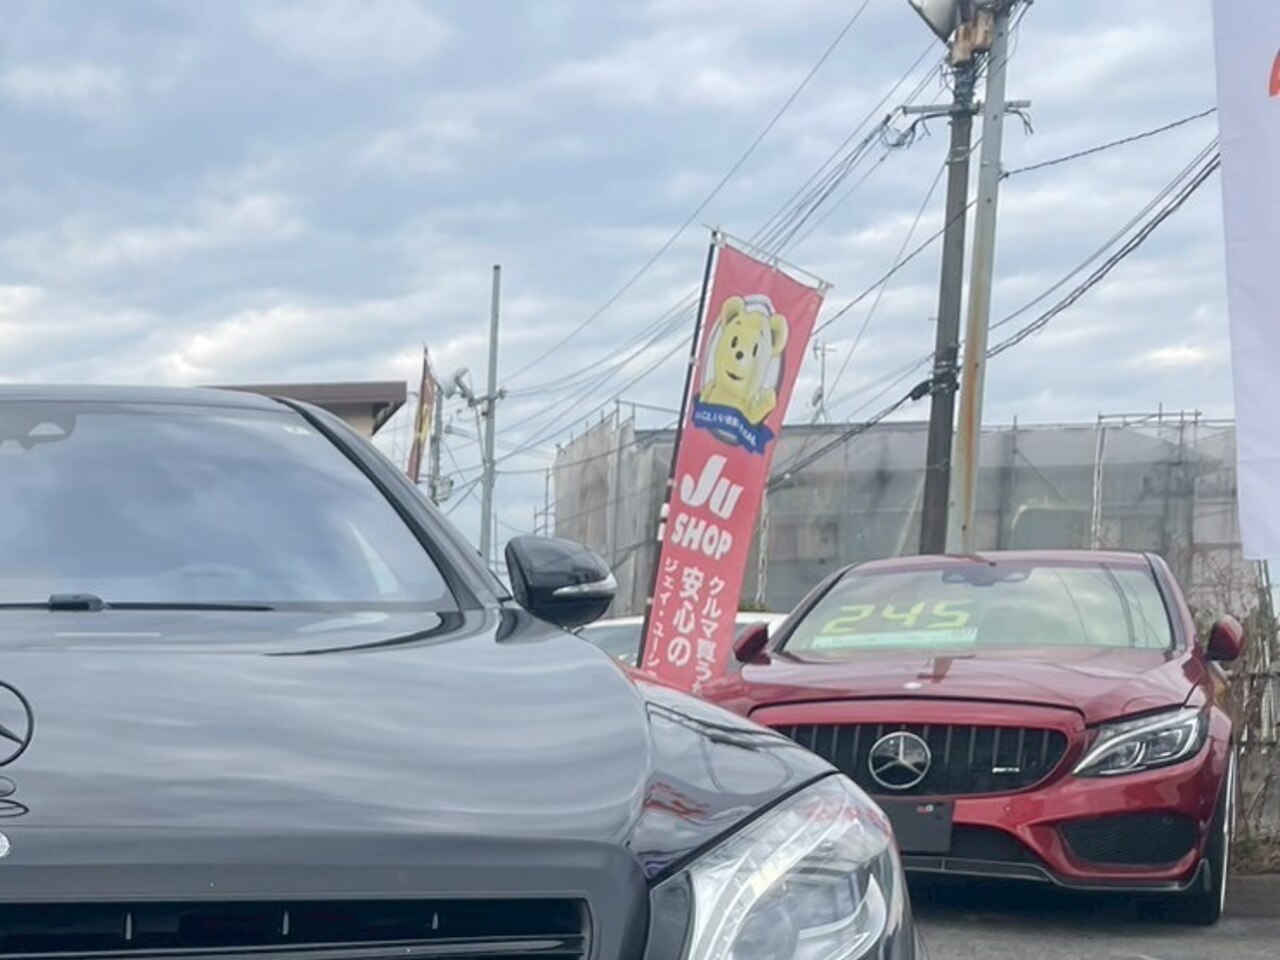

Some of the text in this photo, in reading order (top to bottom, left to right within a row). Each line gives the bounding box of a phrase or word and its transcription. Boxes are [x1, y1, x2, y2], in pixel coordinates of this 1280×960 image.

[671, 512, 733, 561] SHOP
[667, 566, 705, 667] 安心の
[821, 601, 971, 634] 245
